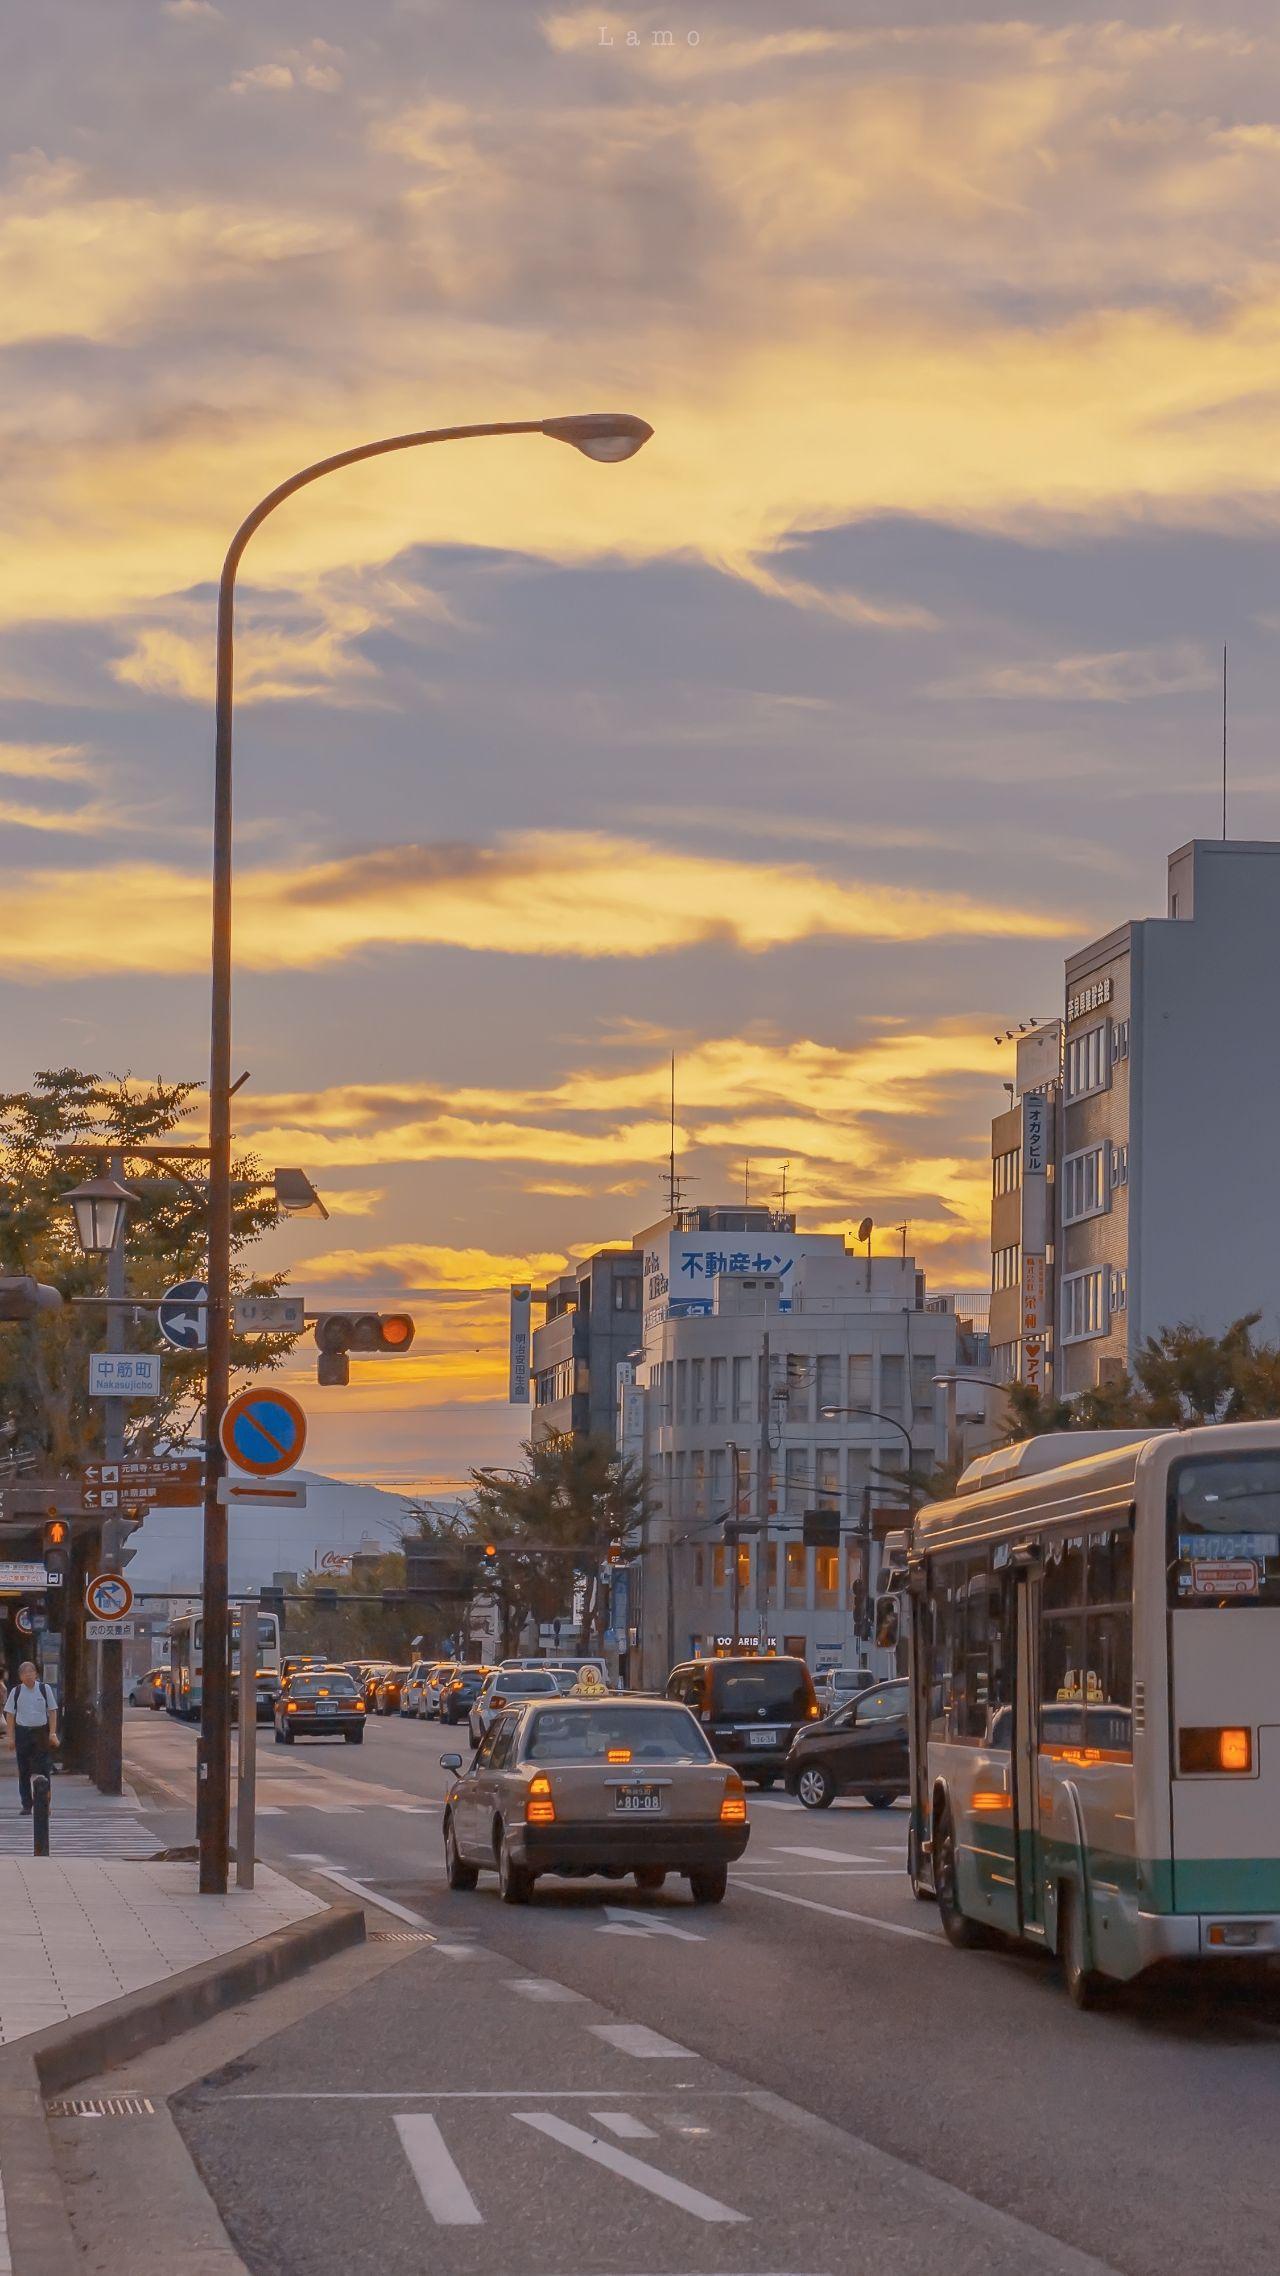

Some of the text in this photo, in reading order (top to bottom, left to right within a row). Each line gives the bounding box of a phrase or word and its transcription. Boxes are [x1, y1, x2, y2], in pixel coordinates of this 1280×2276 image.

[1029, 1110, 1041, 1169] オガタビル
[681, 1252, 794, 1279] 不動産セン
[98, 1361, 151, 1378] 中筋町
[96, 1380, 152, 1391] Nakasujicho
[737, 1637, 759, 1646] ARIS
[625, 1796, 659, 1808] 80-08
